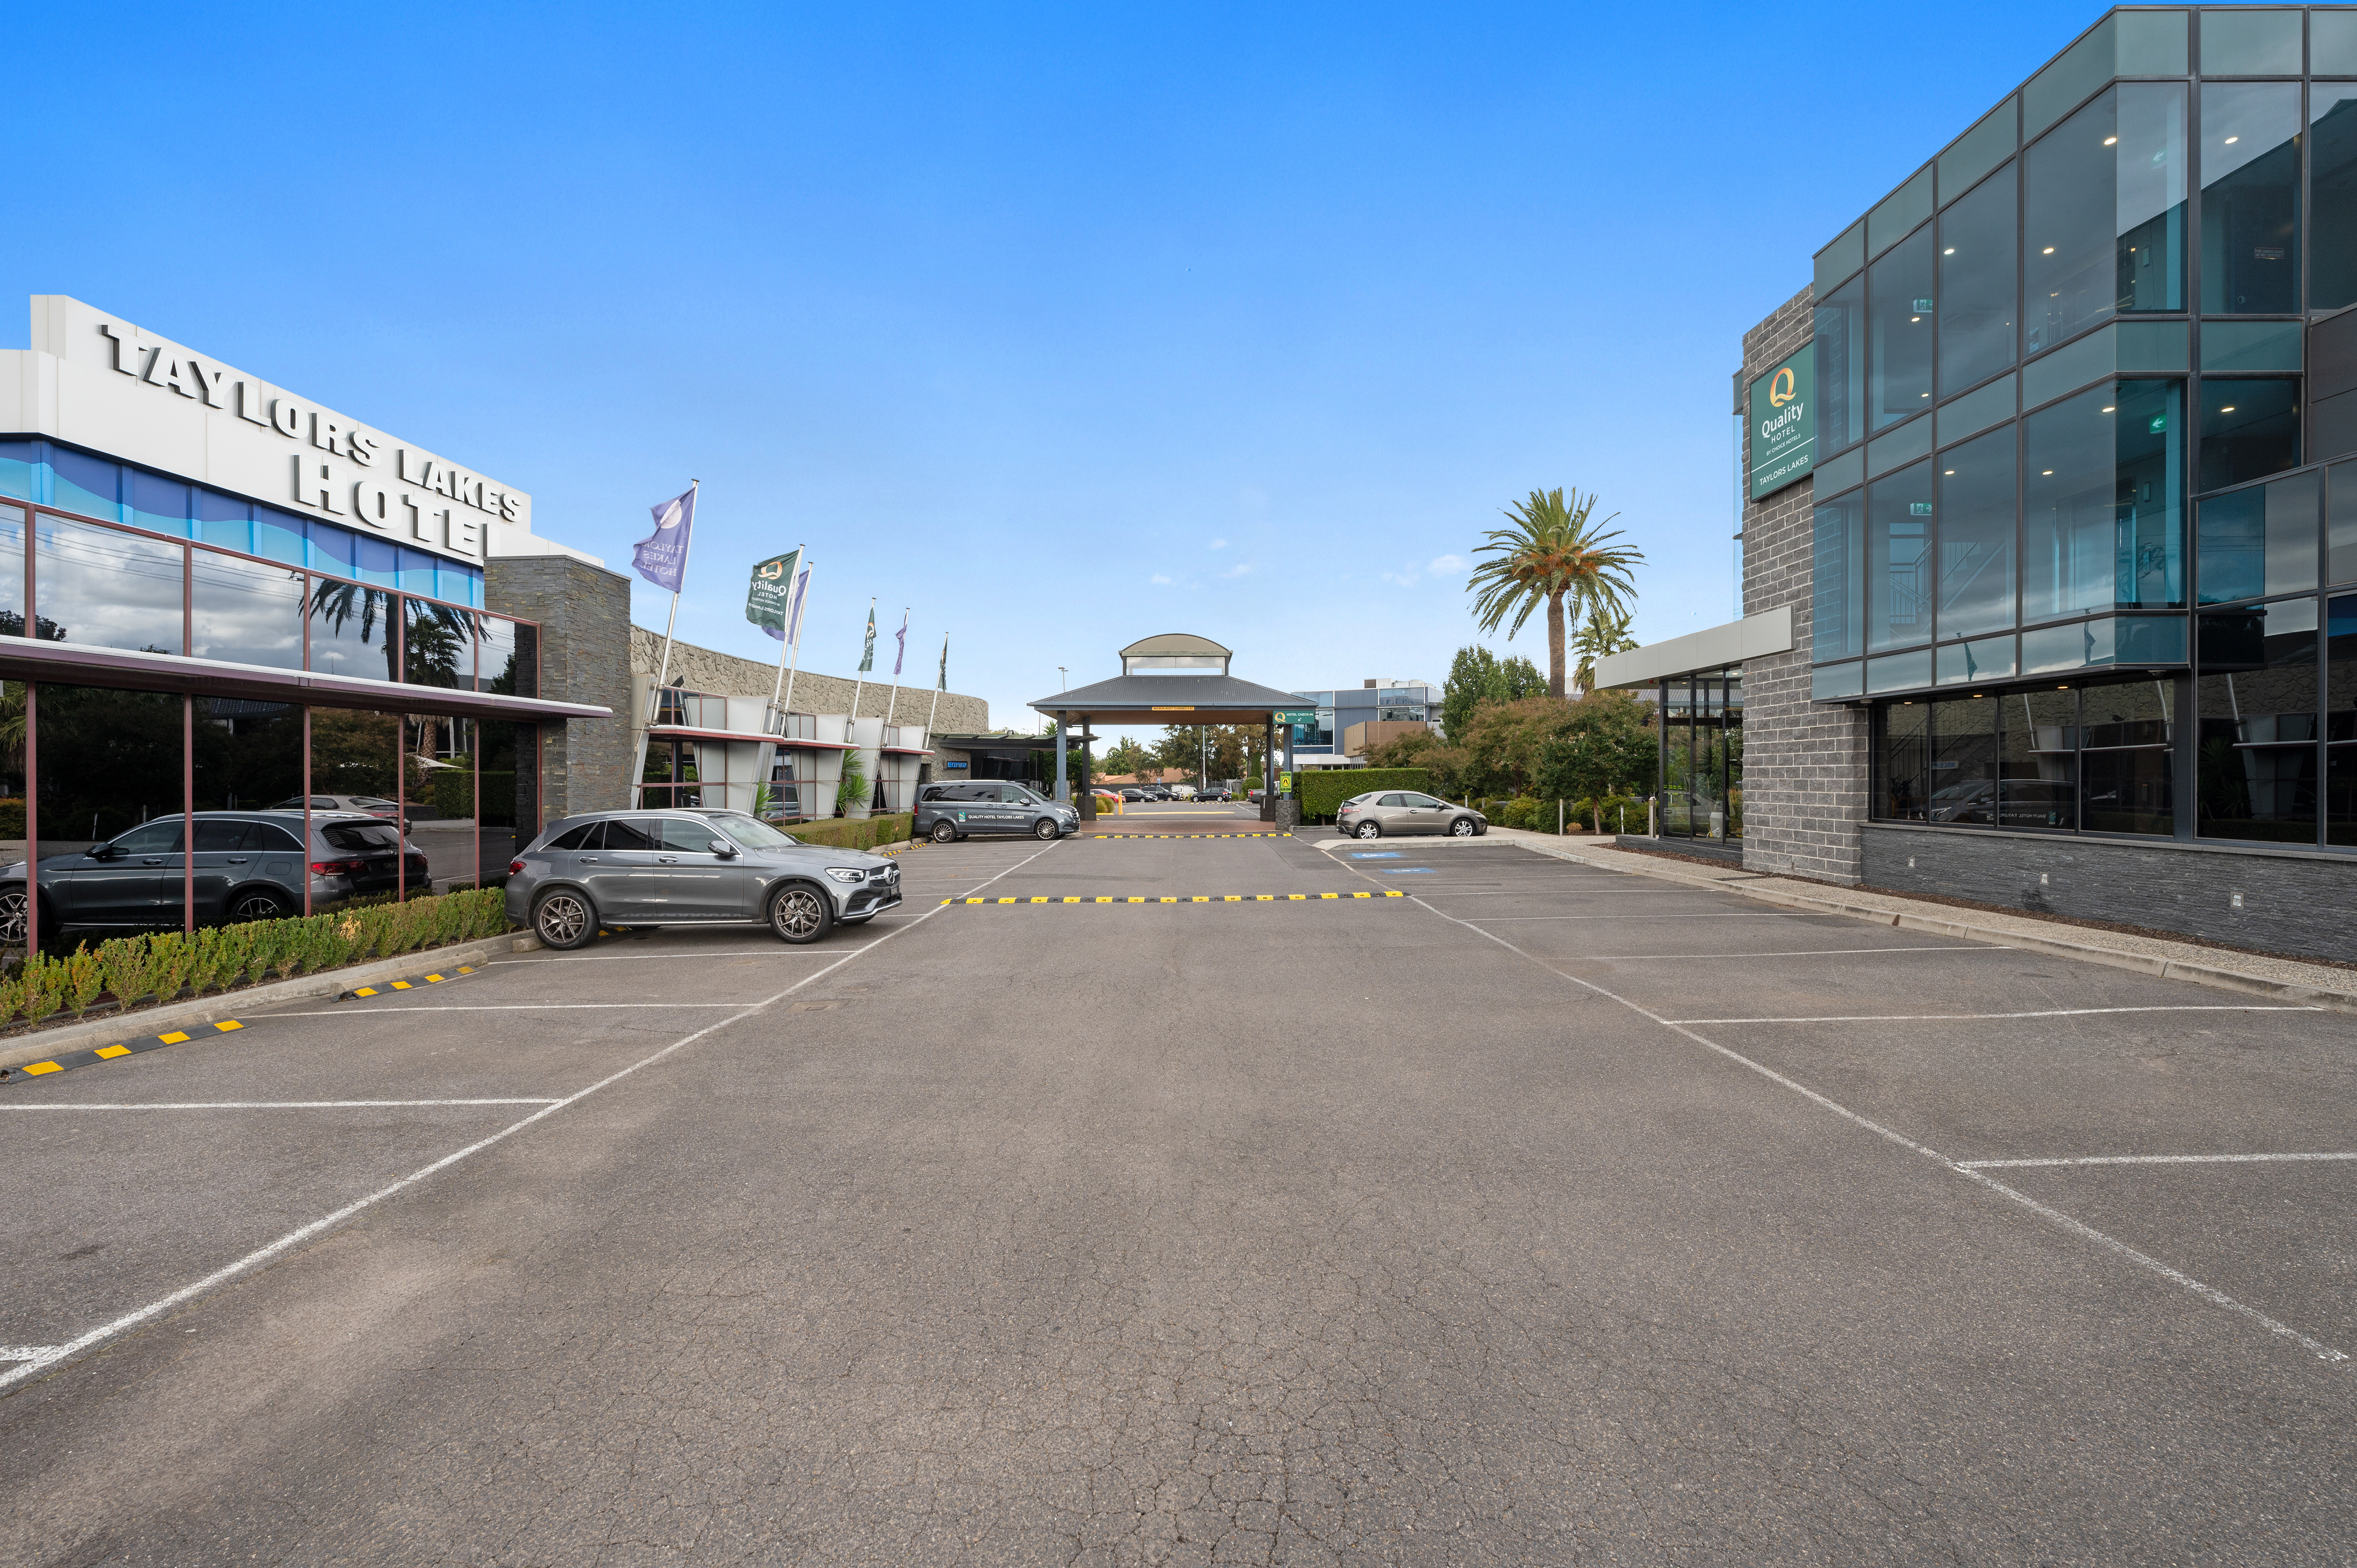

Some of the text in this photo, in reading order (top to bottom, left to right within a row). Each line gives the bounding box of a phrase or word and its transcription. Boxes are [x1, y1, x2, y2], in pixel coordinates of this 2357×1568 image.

[102, 324, 523, 523] TAYLORS LAKES
[1762, 402, 1804, 438] Quality
[1771, 425, 1795, 444] HOTEL
[1772, 441, 1786, 453] CHOICE
[1786, 433, 1801, 445] HOTELS
[1759, 454, 1808, 486] TAYLORS LAKES
